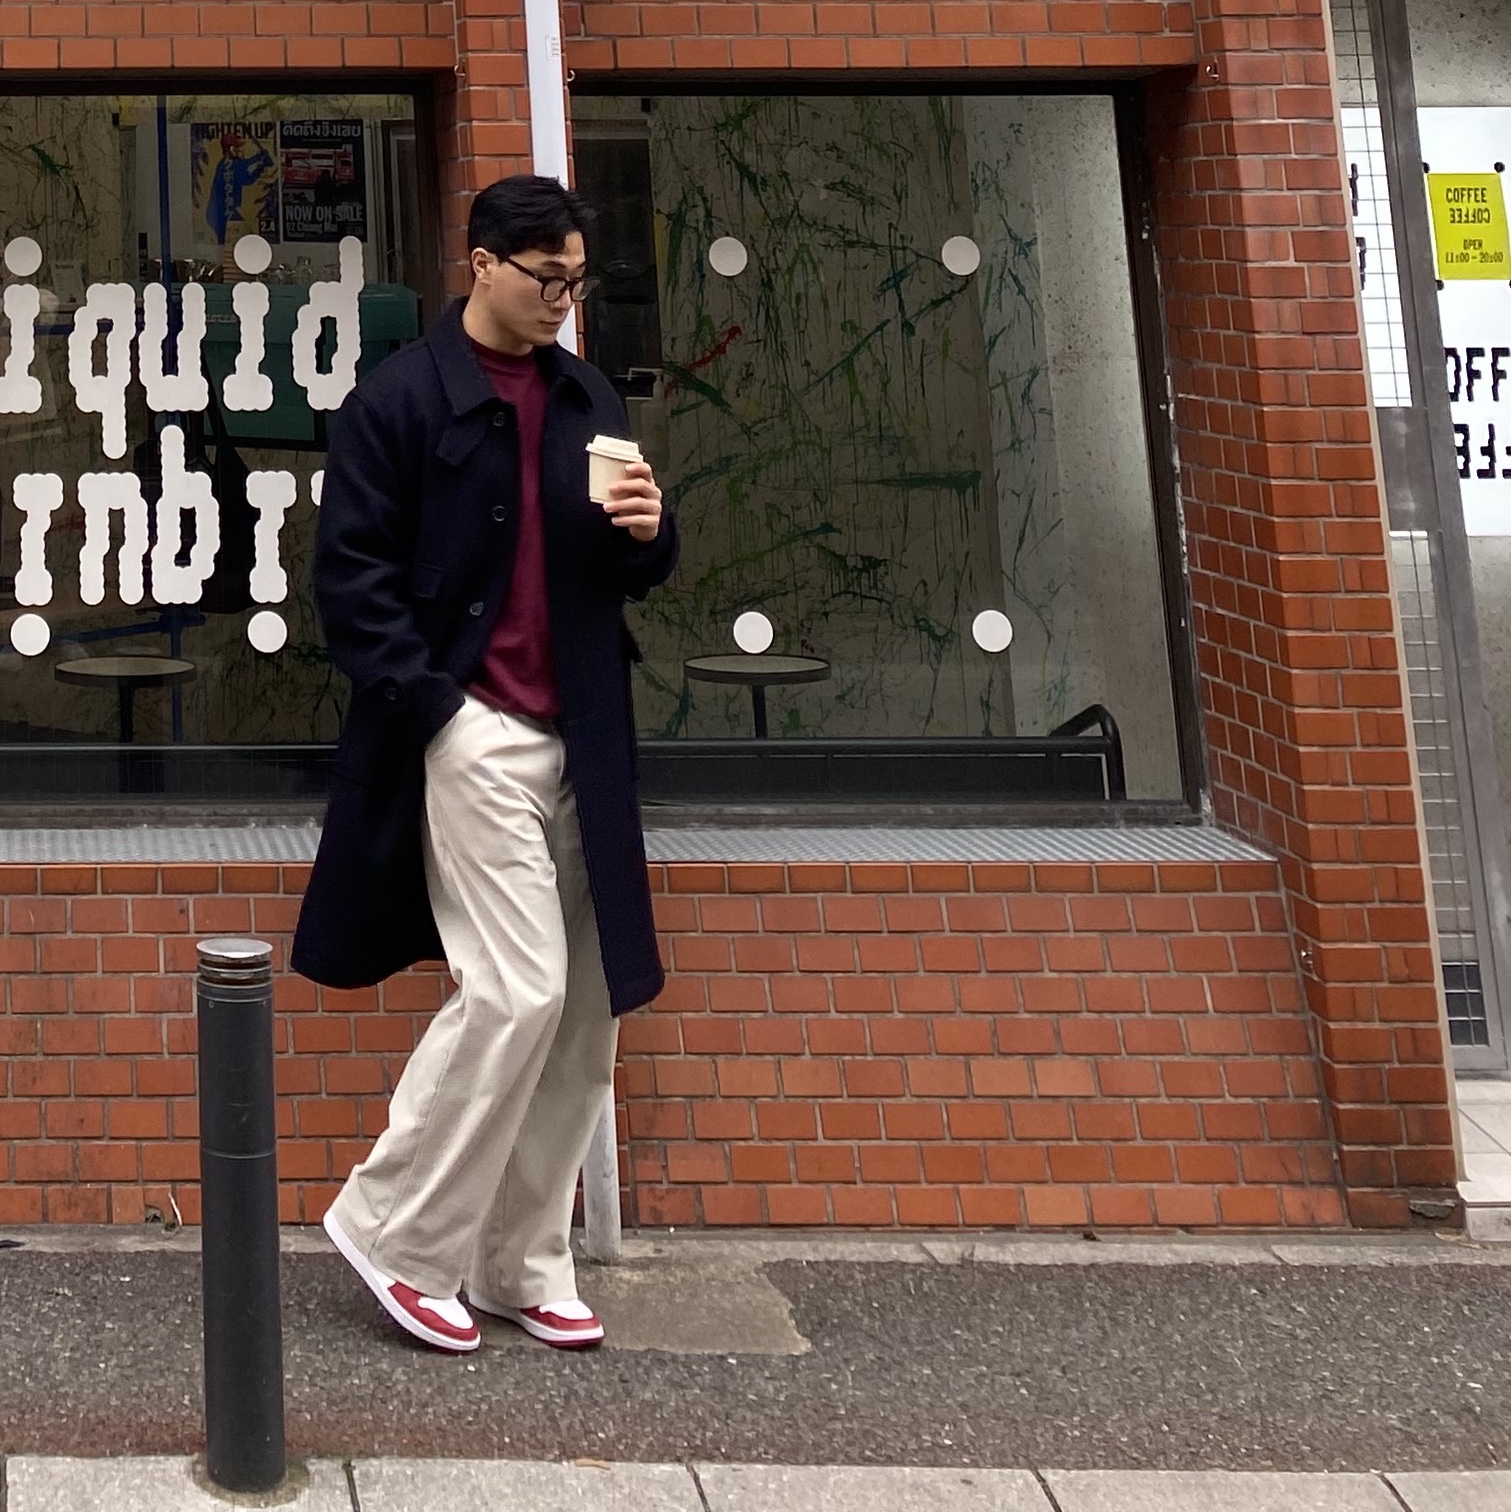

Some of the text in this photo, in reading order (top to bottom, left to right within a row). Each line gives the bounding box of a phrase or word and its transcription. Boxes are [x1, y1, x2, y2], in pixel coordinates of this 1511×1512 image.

[254, 122, 273, 139] UP
[1445, 187, 1488, 203] COFFEE
[285, 204, 364, 222] NOW ON SALE
[1463, 239, 1483, 250] OPEN
